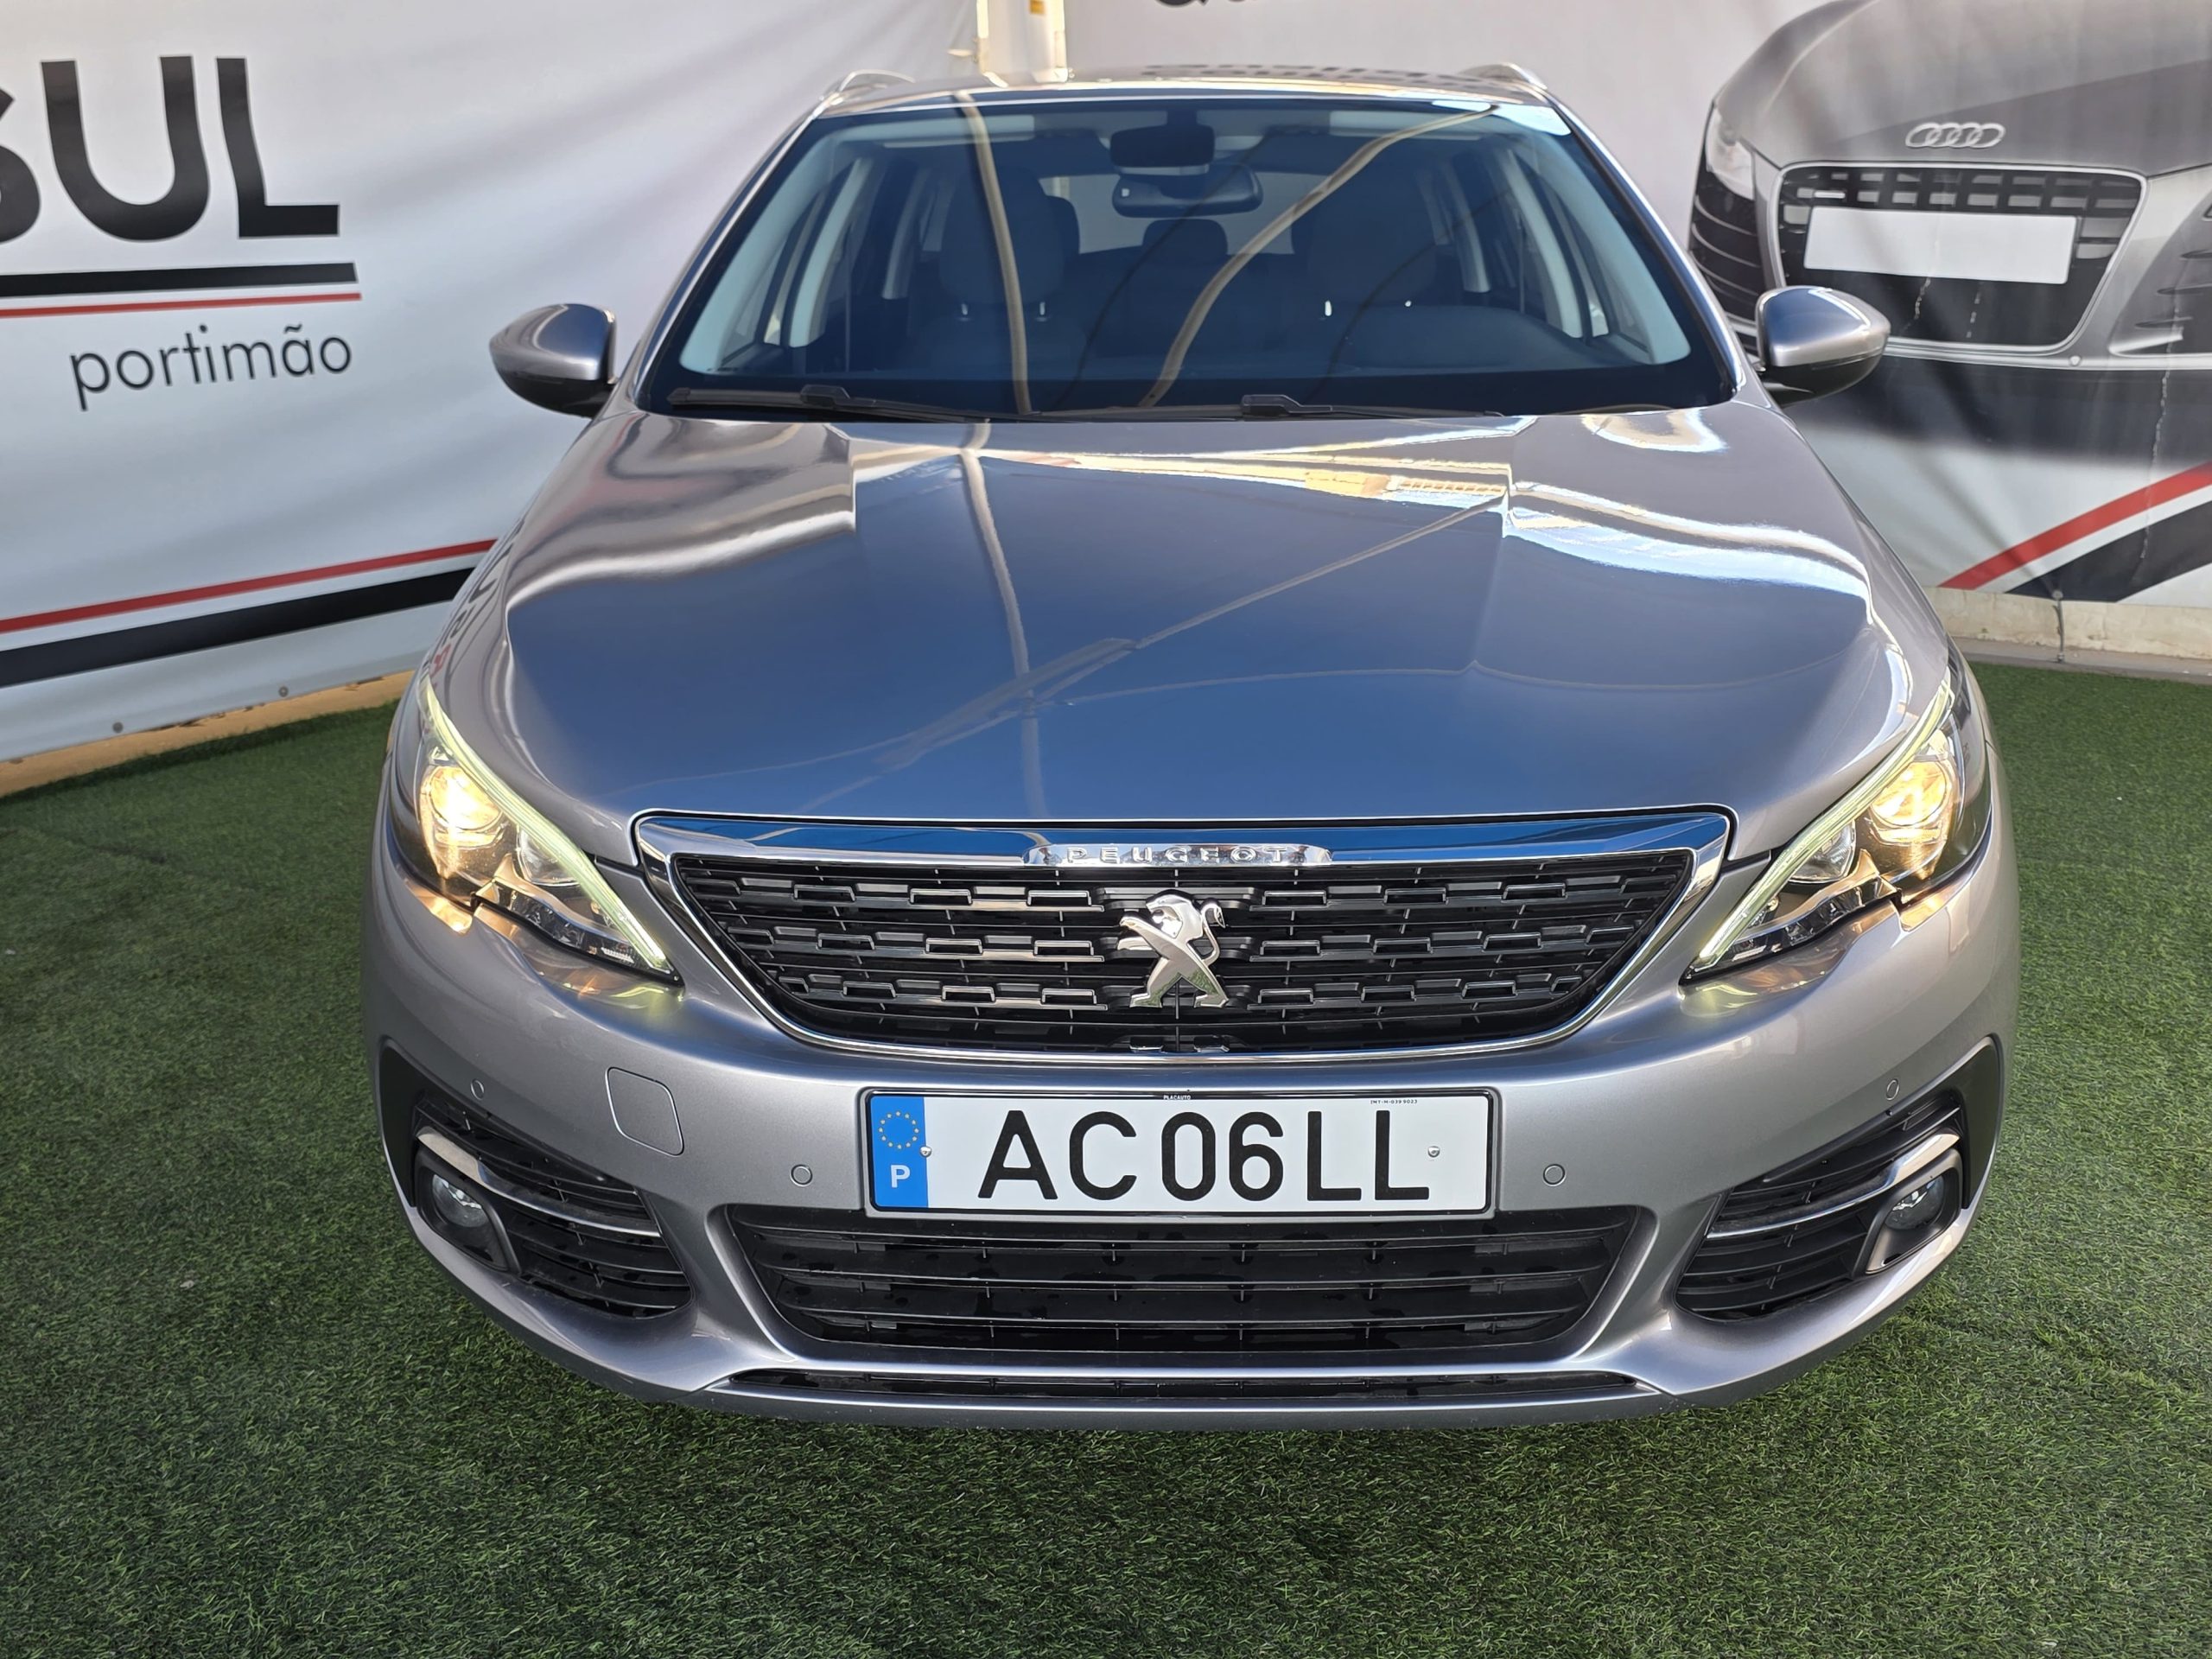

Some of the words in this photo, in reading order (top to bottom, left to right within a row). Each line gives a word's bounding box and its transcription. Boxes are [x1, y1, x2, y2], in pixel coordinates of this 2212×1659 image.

[70, 324, 352, 411] portimão
[1067, 846, 1287, 863] PEUGEOT
[890, 1164, 911, 1188] P
